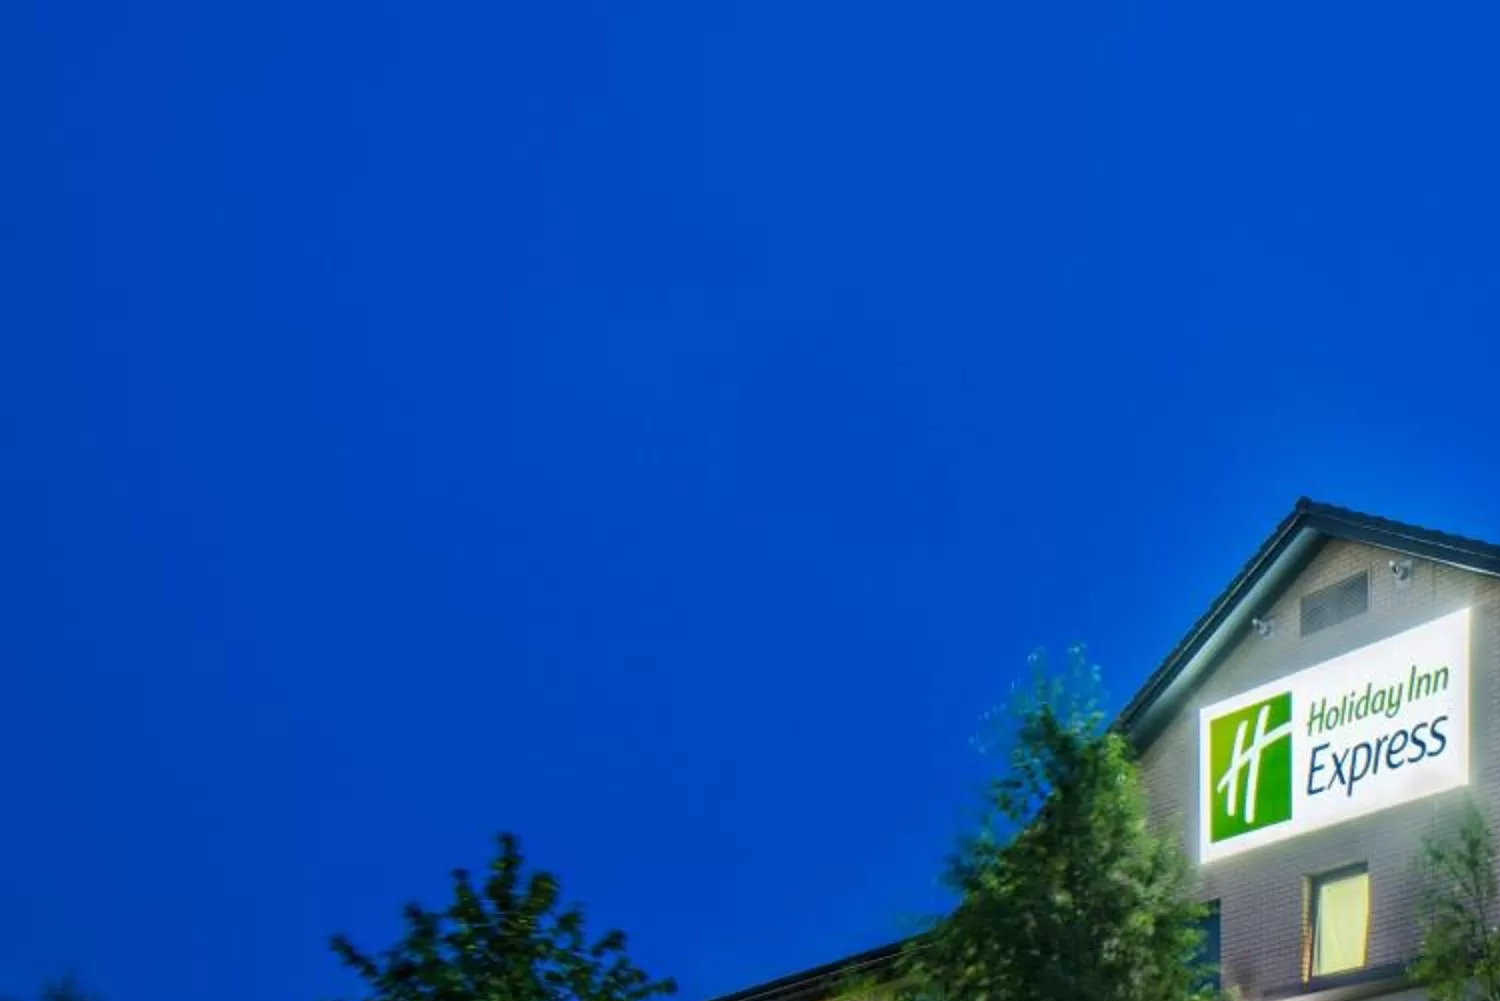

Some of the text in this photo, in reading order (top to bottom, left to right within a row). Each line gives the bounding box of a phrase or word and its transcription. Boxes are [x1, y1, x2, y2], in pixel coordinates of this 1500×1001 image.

[1306, 665, 1449, 737] Holiday Inn
[1306, 715, 1448, 797] Express
